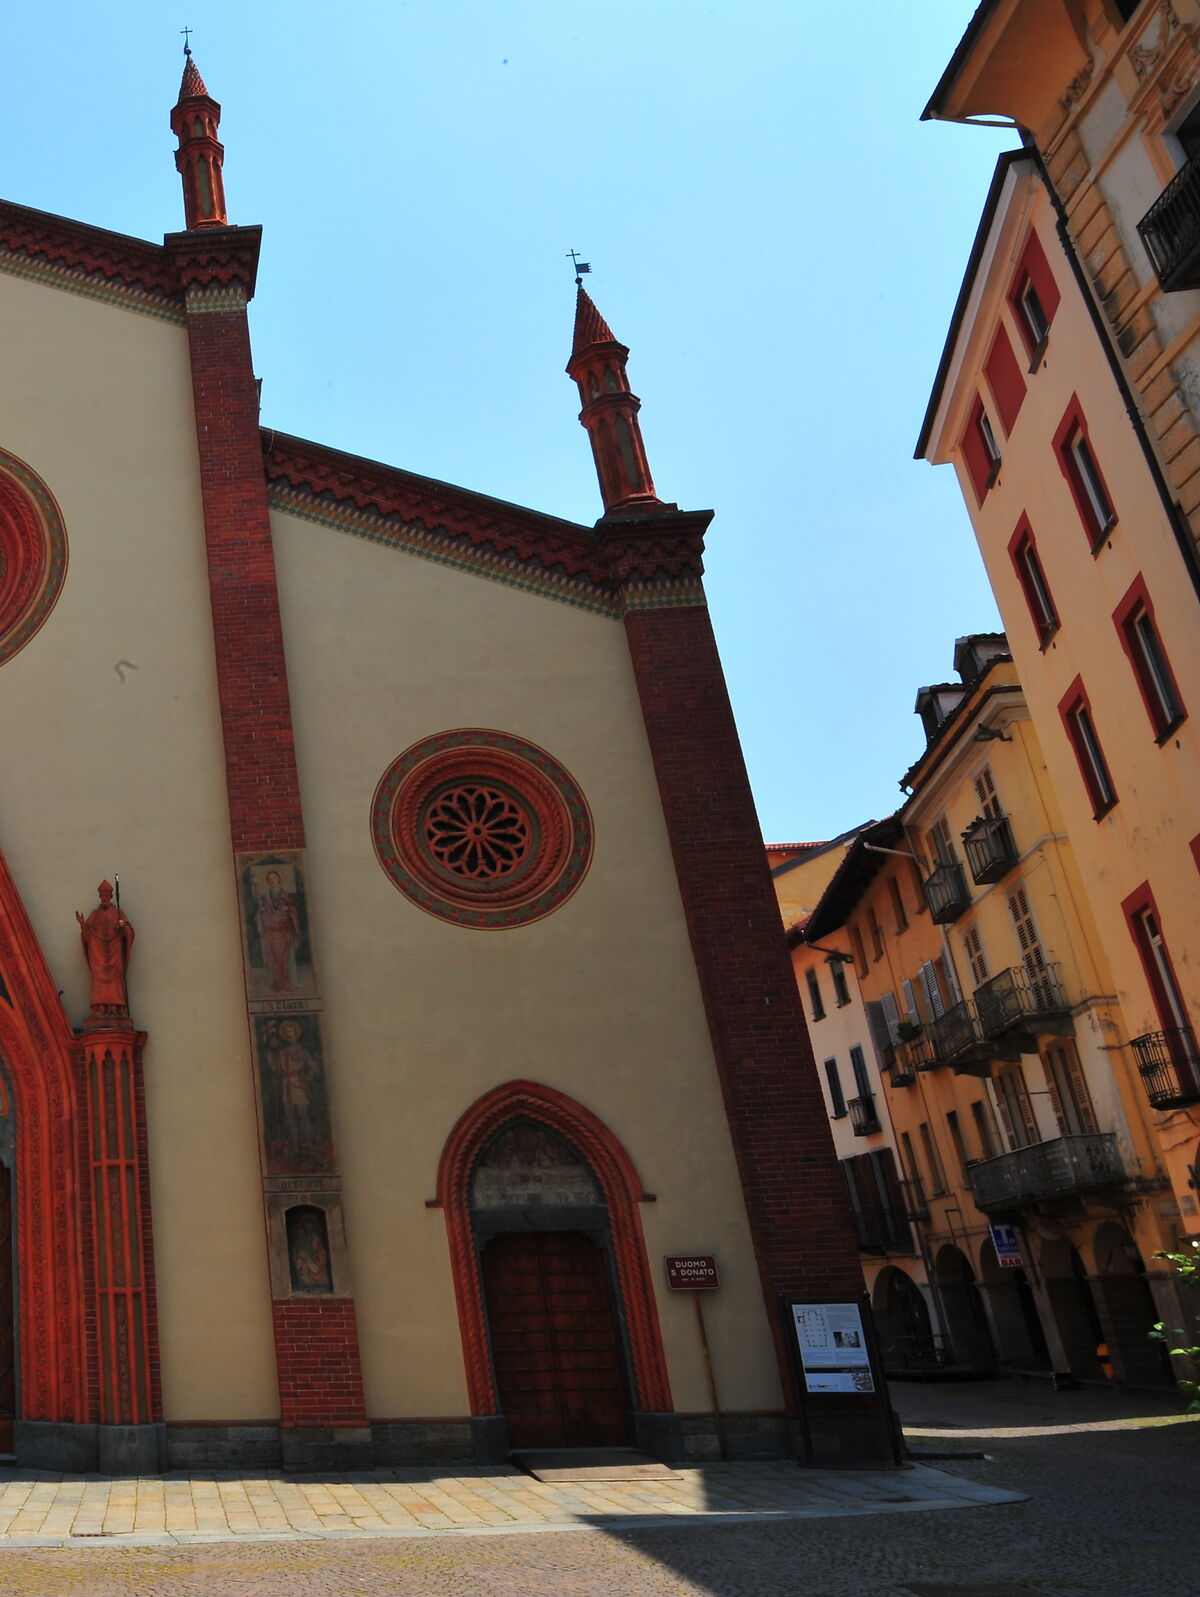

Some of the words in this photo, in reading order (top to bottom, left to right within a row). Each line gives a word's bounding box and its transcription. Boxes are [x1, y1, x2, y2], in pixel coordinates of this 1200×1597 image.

[675, 1260, 707, 1268] DUOMO
[1001, 1257, 1022, 1267] BAR
[680, 1268, 714, 1276] DONATO
